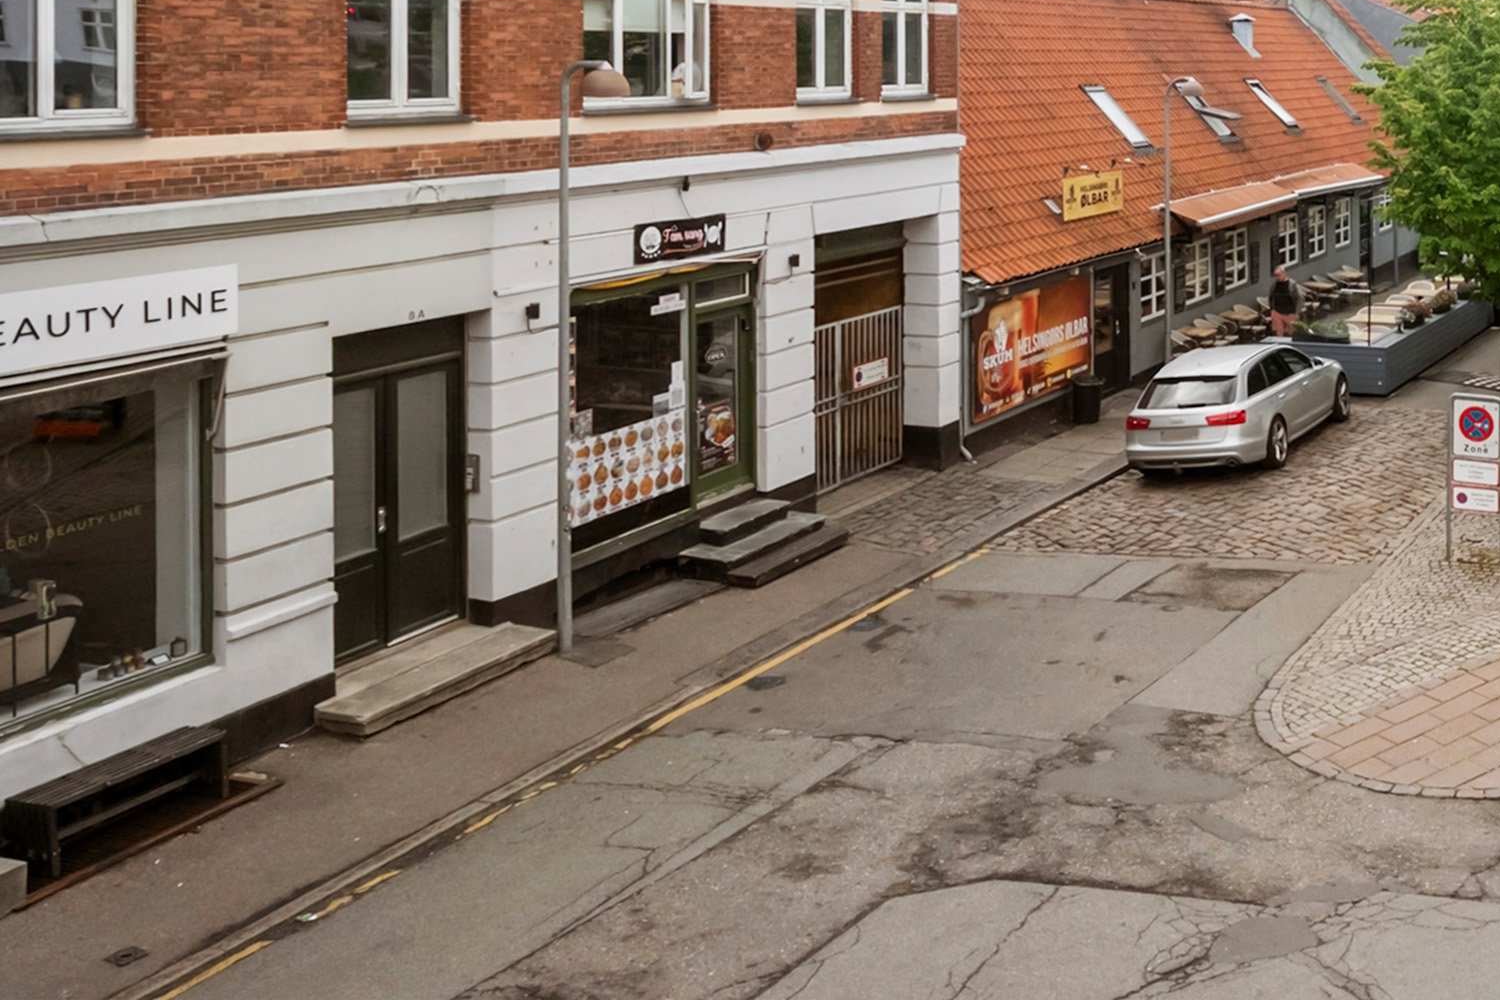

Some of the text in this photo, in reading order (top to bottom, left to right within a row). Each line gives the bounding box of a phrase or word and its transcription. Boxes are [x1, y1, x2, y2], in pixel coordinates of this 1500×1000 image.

[1081, 190, 1109, 208] ØLBAR
[0, 289, 228, 346] AUTY LINE
[983, 348, 1013, 370] SKUM
[1464, 443, 1489, 453] Zone
[109, 505, 142, 522] LINE
